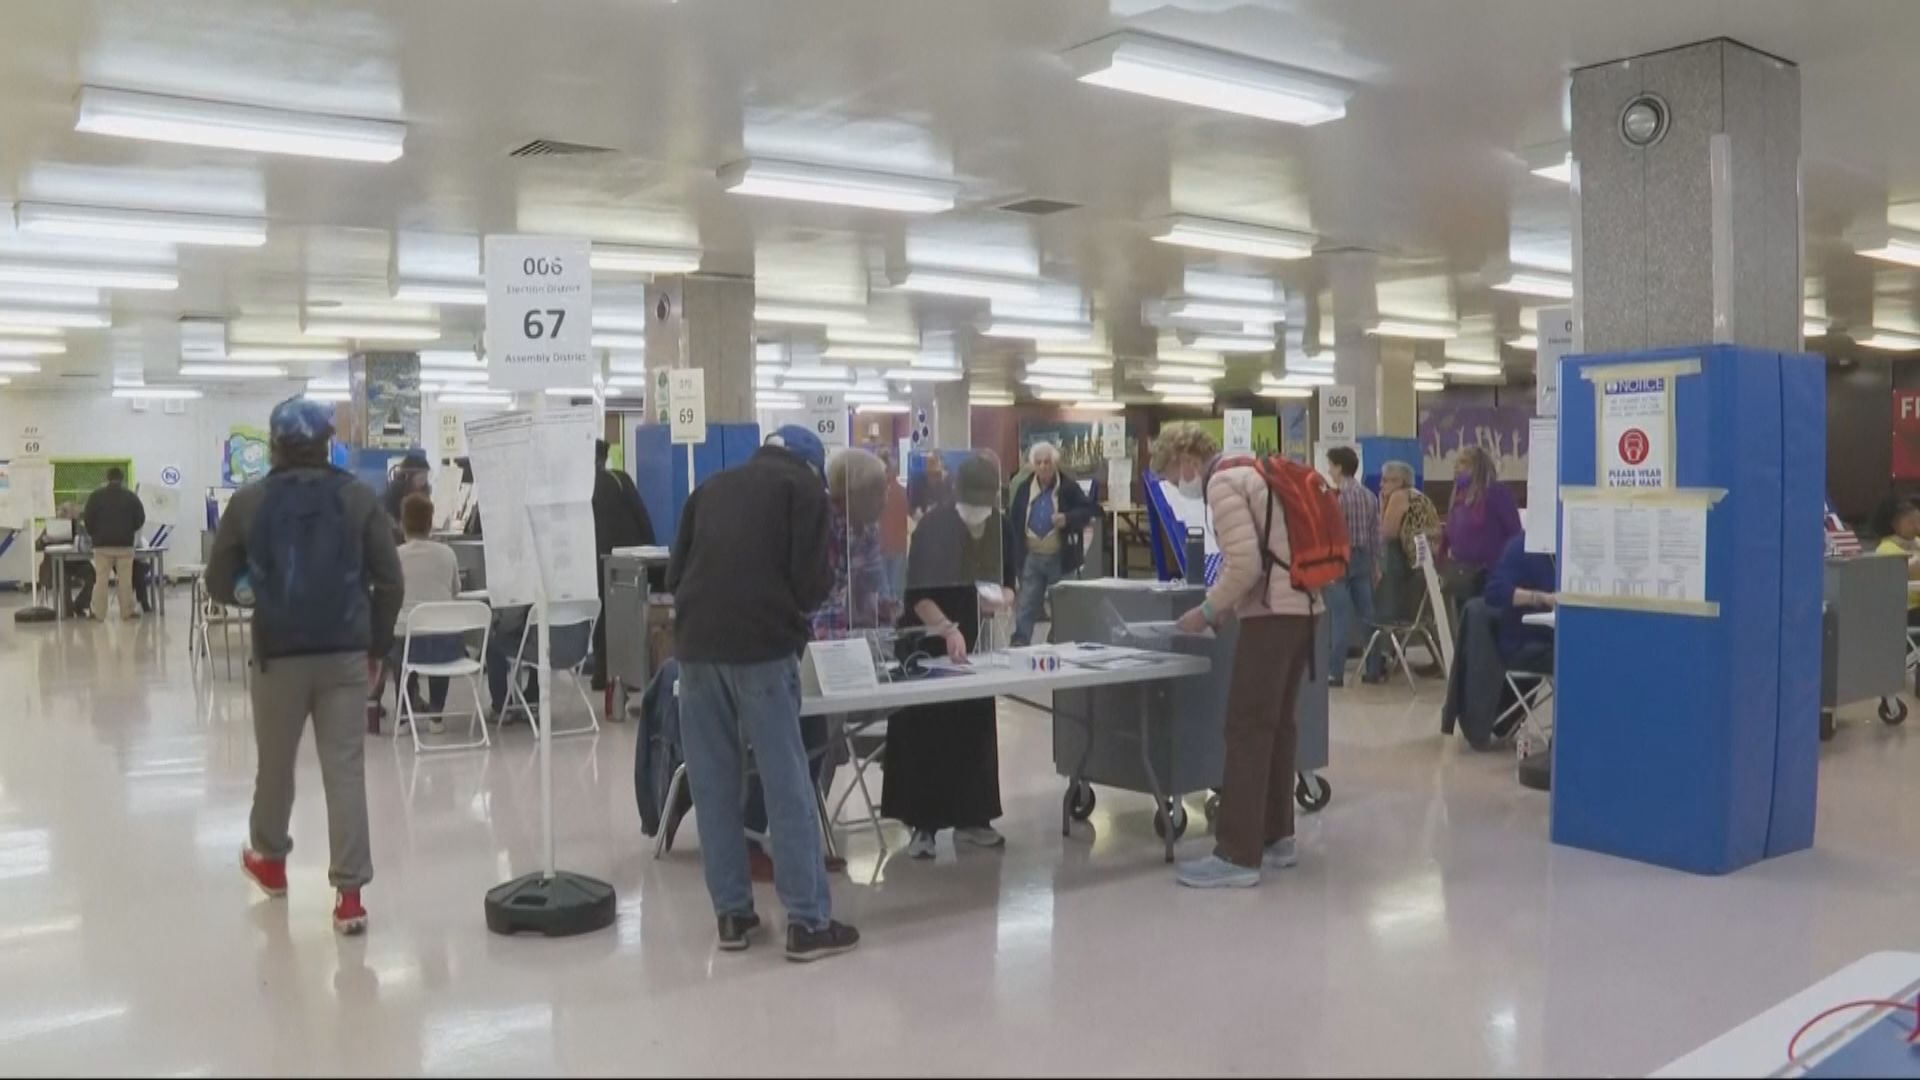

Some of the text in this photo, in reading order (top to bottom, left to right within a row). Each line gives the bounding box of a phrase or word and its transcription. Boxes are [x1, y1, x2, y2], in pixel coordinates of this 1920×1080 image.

[523, 257, 563, 276] 006
[506, 283, 581, 295] Election District
[523, 309, 566, 339] 67
[505, 351, 587, 364] Assembly District
[1328, 396, 1348, 408] 069
[680, 408, 694, 424] 69
[817, 420, 835, 433] 69
[1331, 422, 1344, 433] 69
[25, 441, 40, 453] 69
[1608, 468, 1662, 479] PLEASE WEAR
[1617, 479, 1636, 488] FACE
[1639, 478, 1662, 487] MASK
